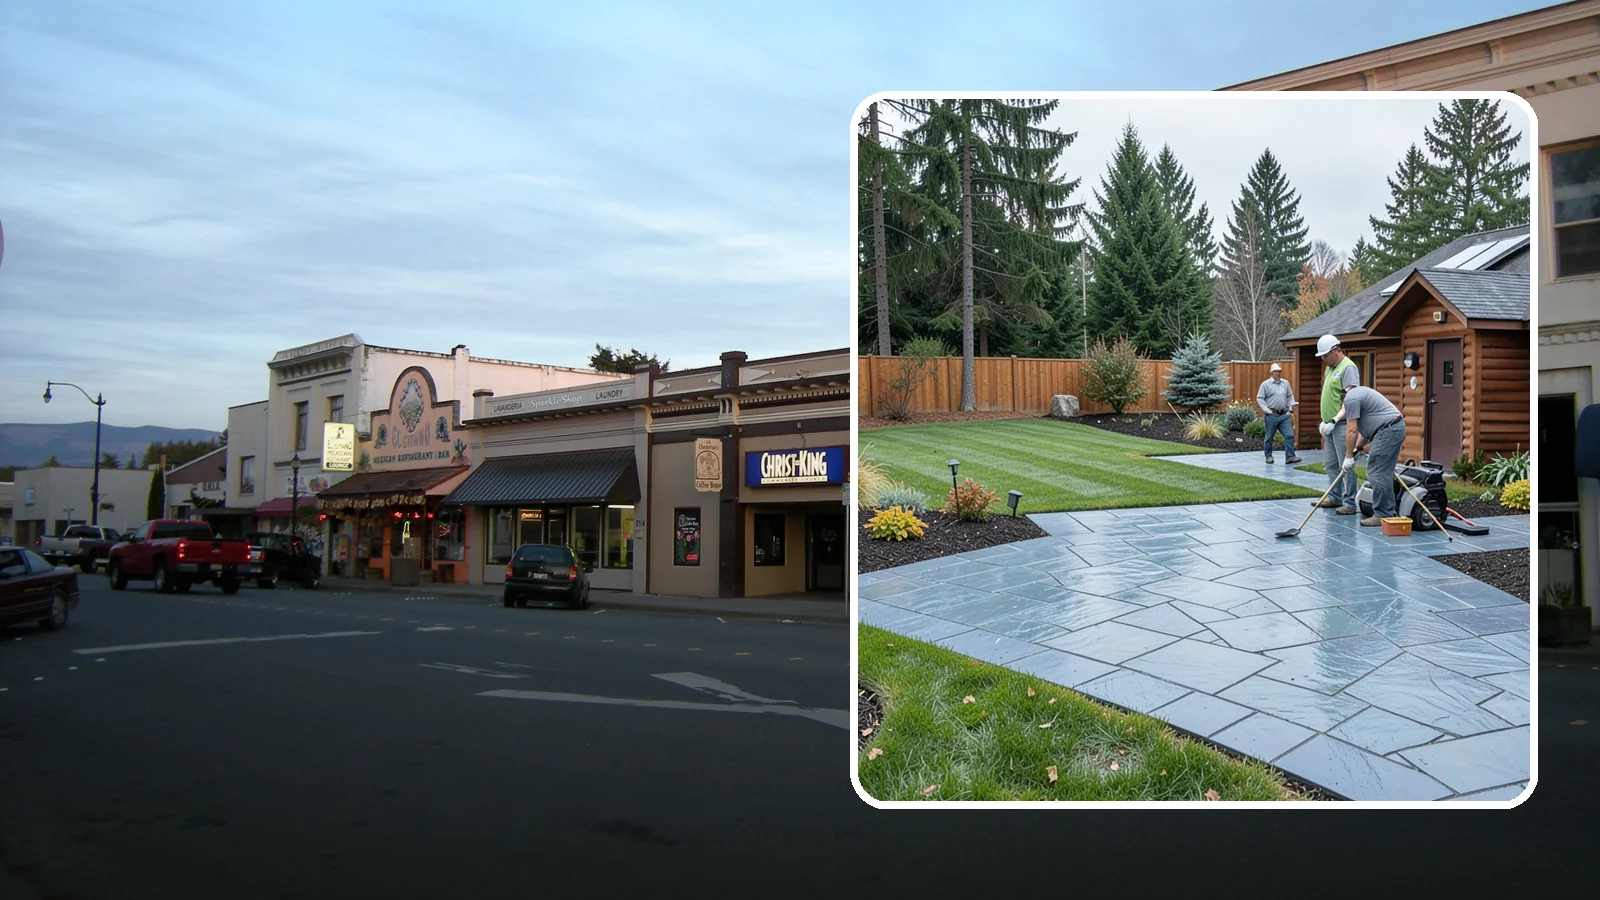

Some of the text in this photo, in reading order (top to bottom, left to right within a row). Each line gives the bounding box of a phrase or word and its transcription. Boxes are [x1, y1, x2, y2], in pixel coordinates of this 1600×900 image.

[493, 388, 624, 413] LAVANDERIA Sparkle Shop LAUNDRY
[373, 454, 396, 464] MEXICAN
[397, 451, 433, 463] RESTAURANT
[437, 450, 450, 459] BAR
[760, 450, 827, 477] CHRIST KING
